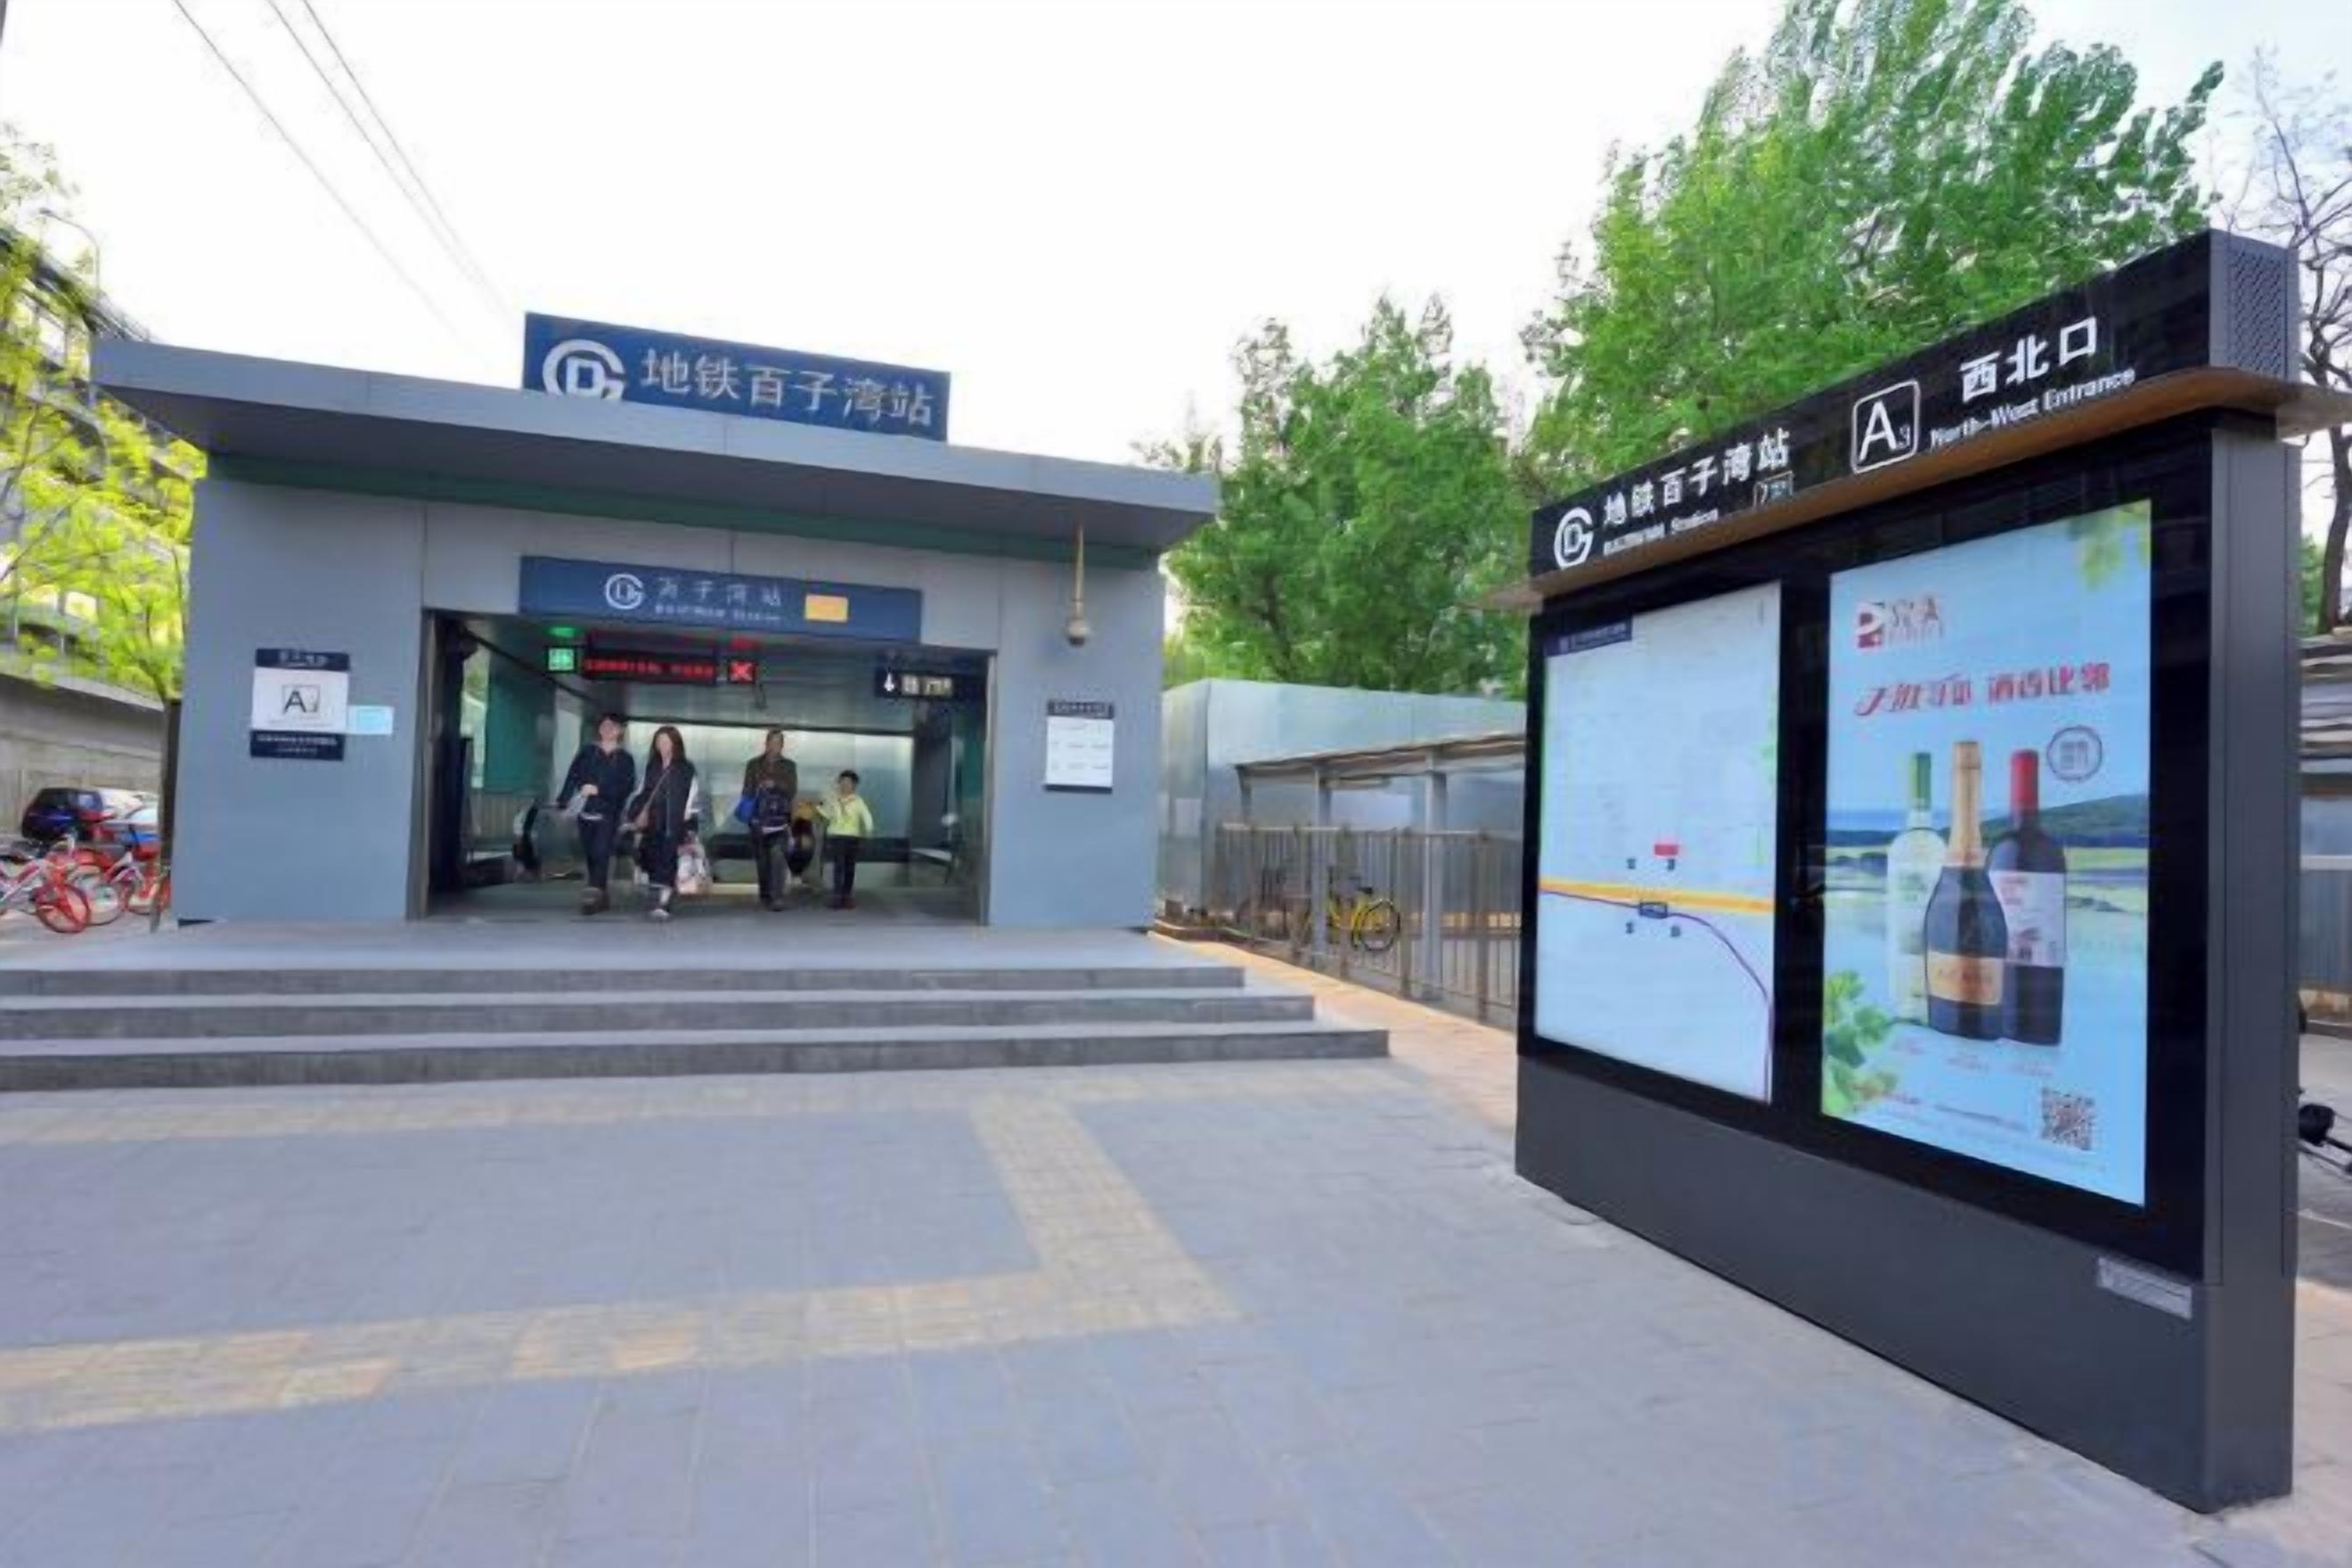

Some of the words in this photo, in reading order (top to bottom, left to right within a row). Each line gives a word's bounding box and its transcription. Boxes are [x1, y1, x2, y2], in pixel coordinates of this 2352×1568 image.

[641, 347, 934, 427] 地铁百子湾站
[1959, 316, 2097, 401] 西北口
[2043, 367, 2136, 412] Entrance
[1858, 400, 1897, 462] A
[1604, 428, 1791, 527] 地铁百子湾站
